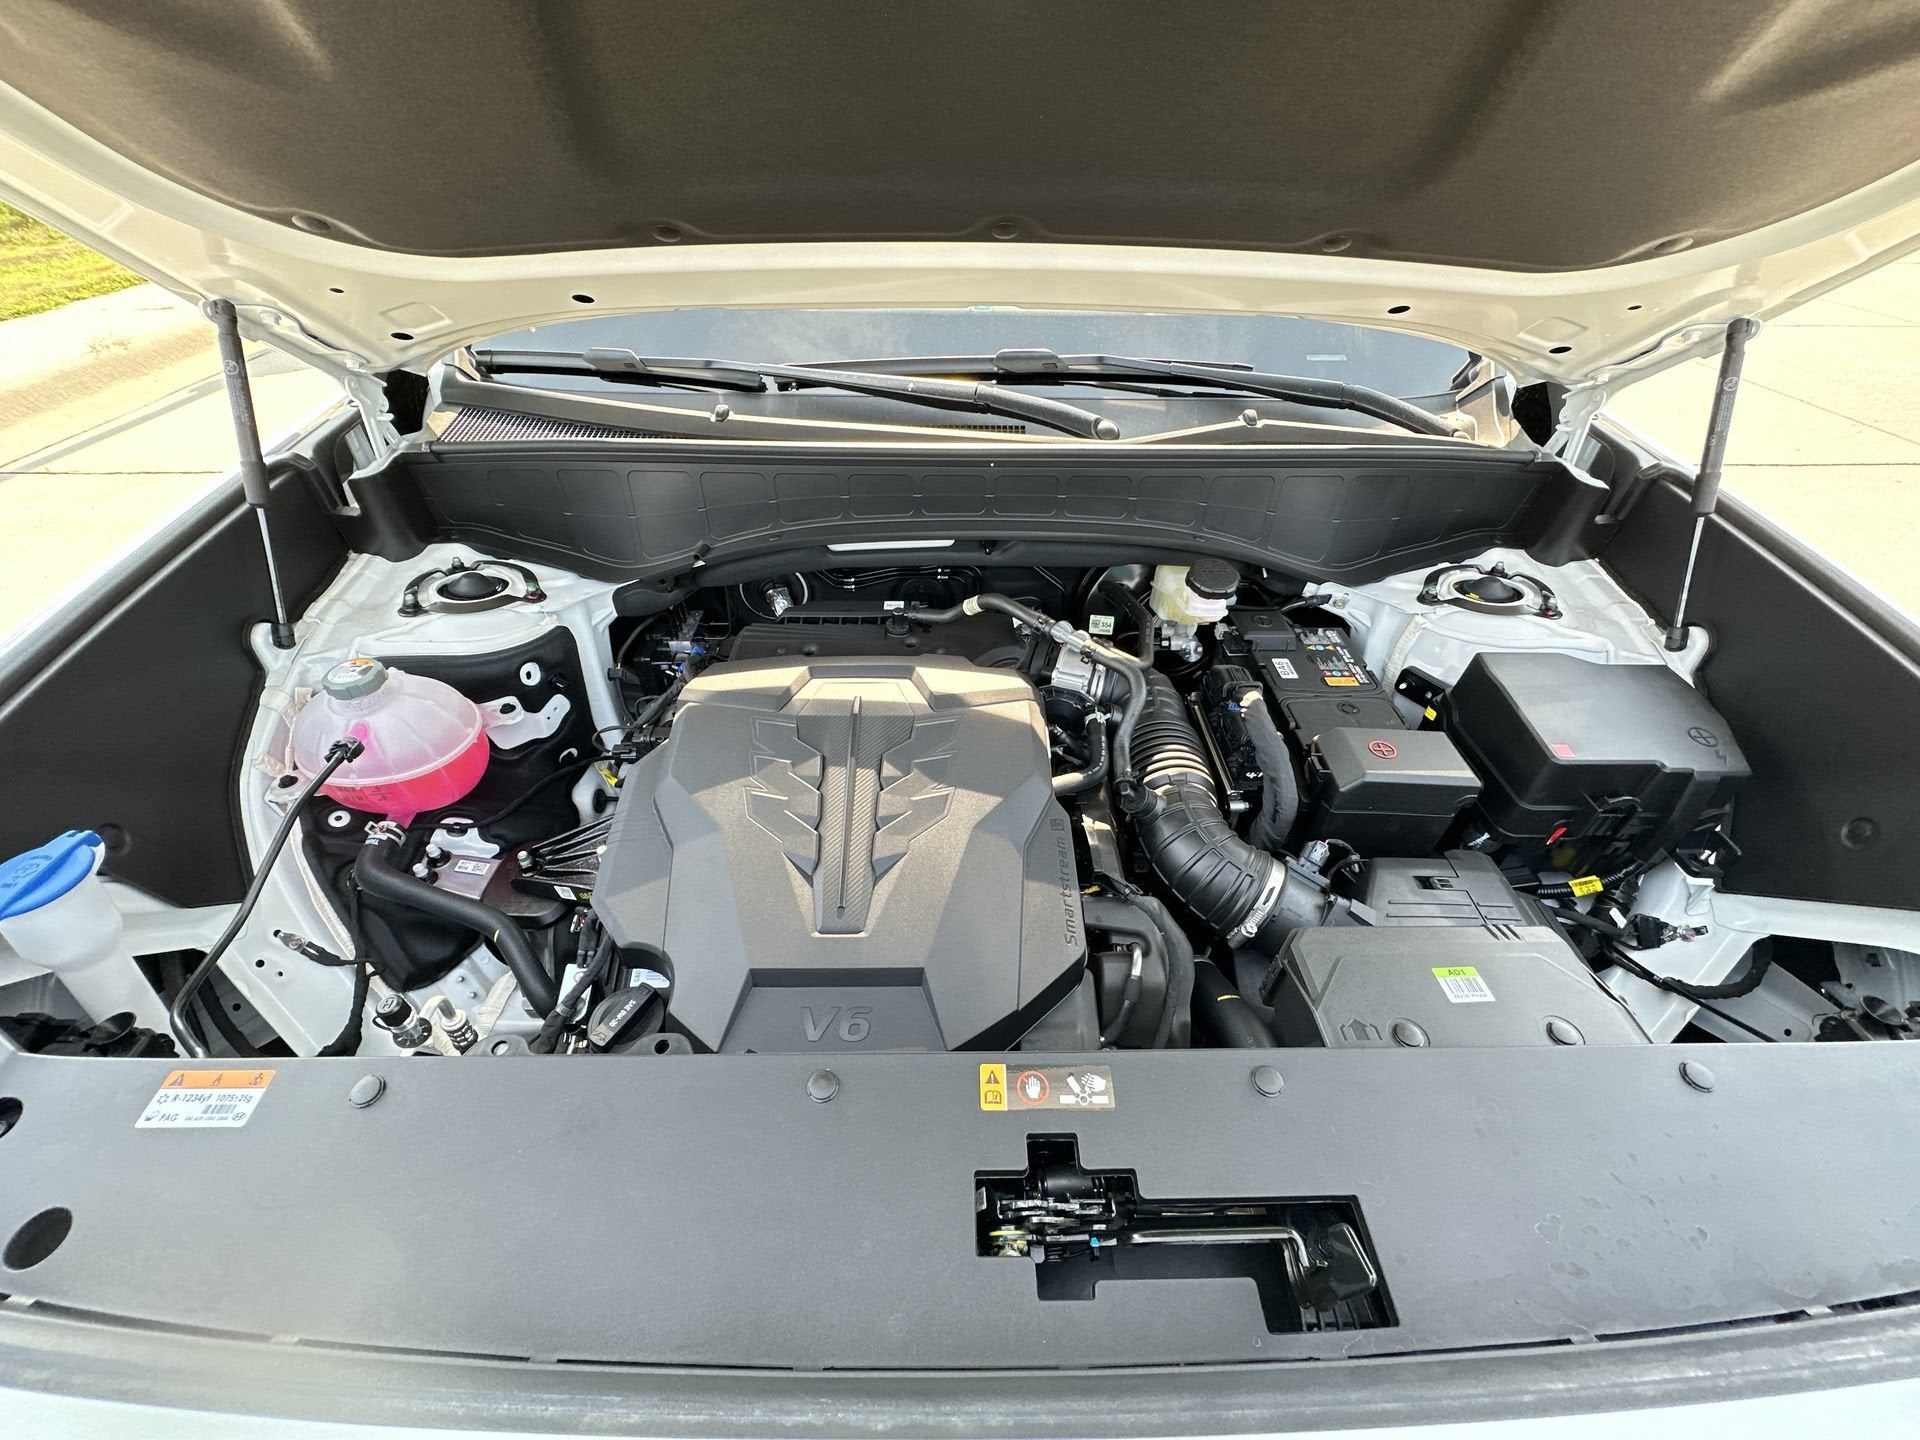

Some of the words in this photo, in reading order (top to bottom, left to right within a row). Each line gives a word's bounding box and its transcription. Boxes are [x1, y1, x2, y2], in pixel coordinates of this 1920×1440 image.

[1057, 836, 1079, 947] Smartstream
[1447, 968, 1467, 977] AD1
[623, 999, 637, 1011] SAE
[800, 1006, 873, 1043] V6
[171, 1093, 214, 1104] R-1234yf
[158, 1113, 179, 1122] PAG
